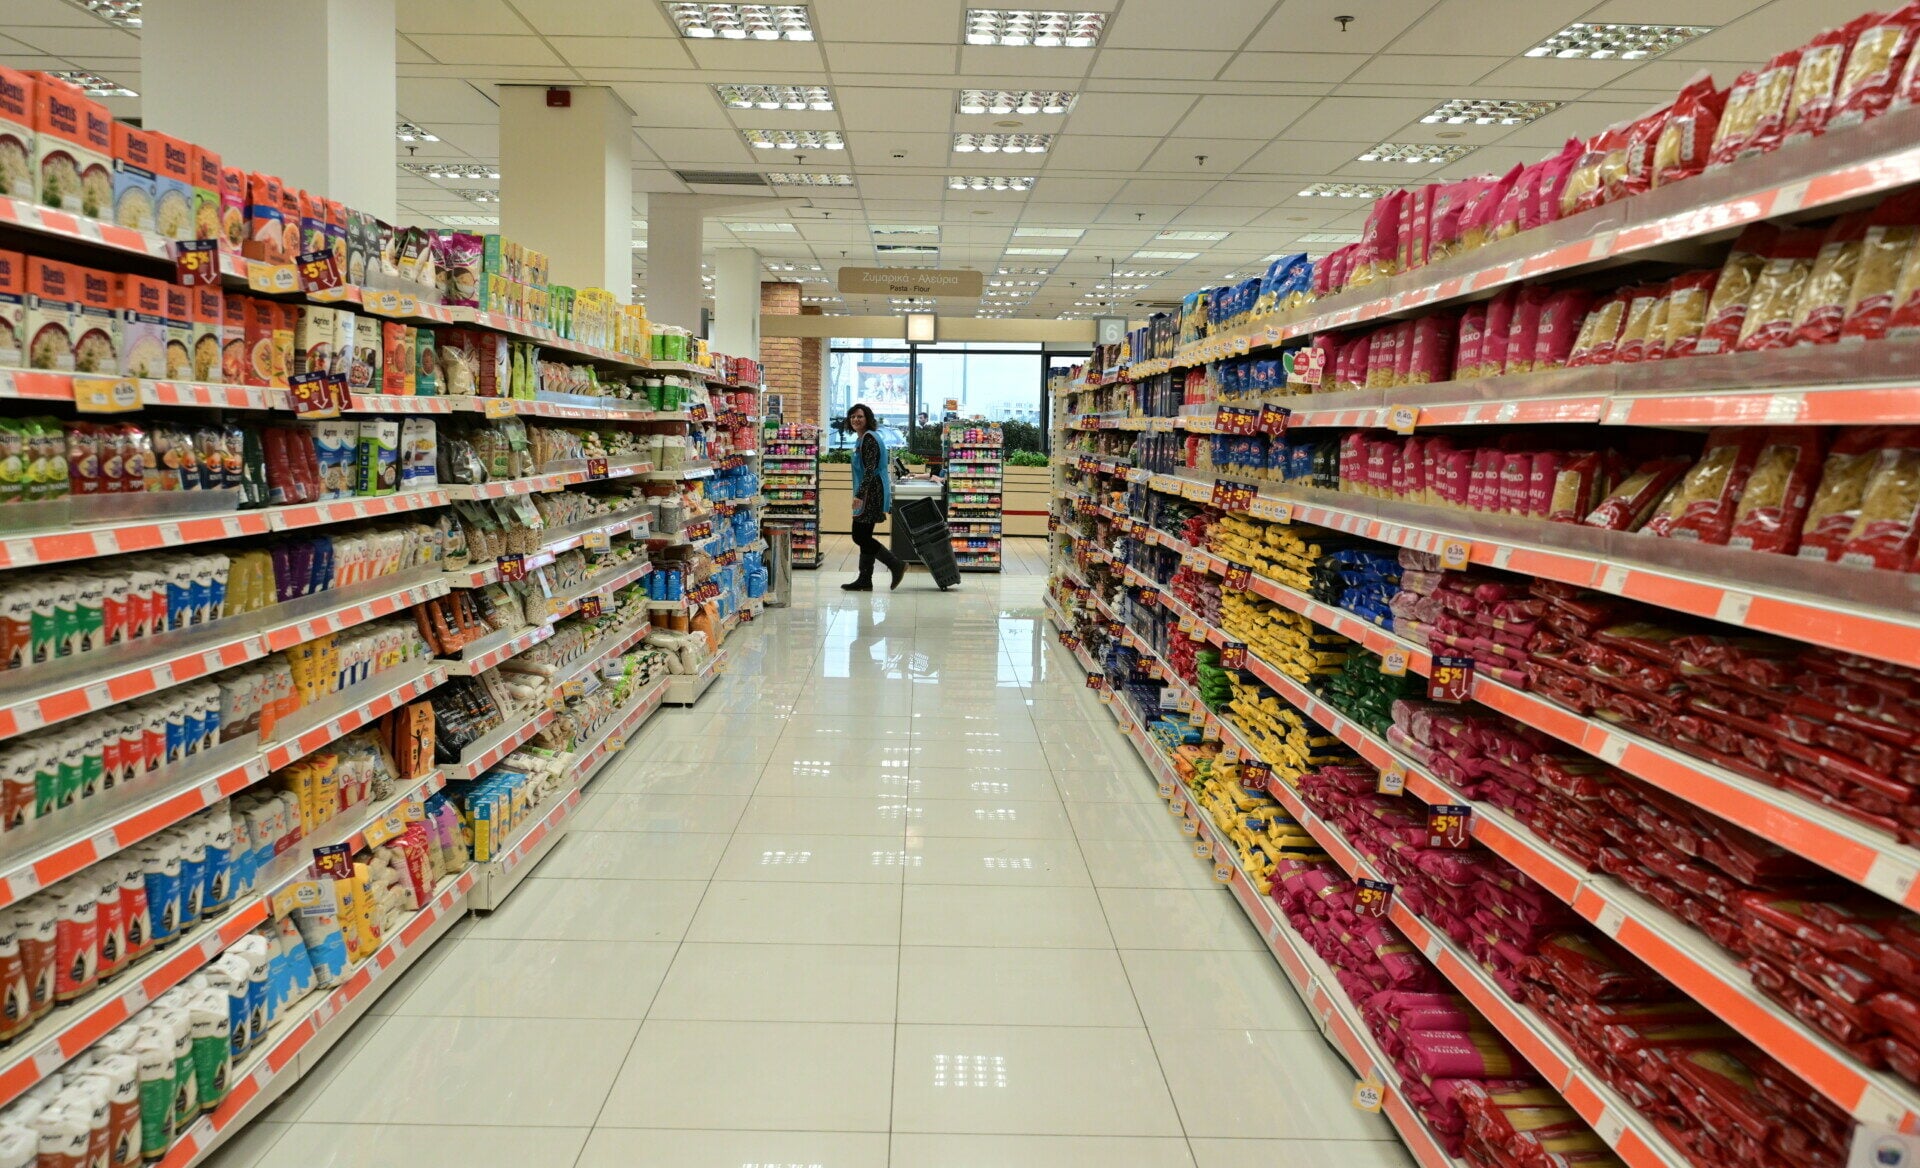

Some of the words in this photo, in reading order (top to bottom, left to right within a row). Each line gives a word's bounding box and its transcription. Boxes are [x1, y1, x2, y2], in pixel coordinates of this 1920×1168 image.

[181, 252, 209, 270] -5%
[302, 261, 327, 279] -5%
[863, 272, 909, 283] Ζυμαρικά
[919, 273, 958, 285] Αλεύρια
[313, 315, 330, 328] Agrino
[1106, 325, 1118, 342] 6
[295, 382, 319, 399] -5%
[1235, 414, 1251, 424] -5%
[1263, 412, 1281, 424] -5%
[501, 561, 518, 572] -5%
[1228, 570, 1243, 579] -5%
[1224, 649, 1240, 658] -5%
[1435, 668, 1462, 684] -5%
[1246, 768, 1263, 778] -5%
[1432, 816, 1458, 832] -5%
[319, 854, 342, 870] -5%
[1358, 889, 1382, 903] -5%
